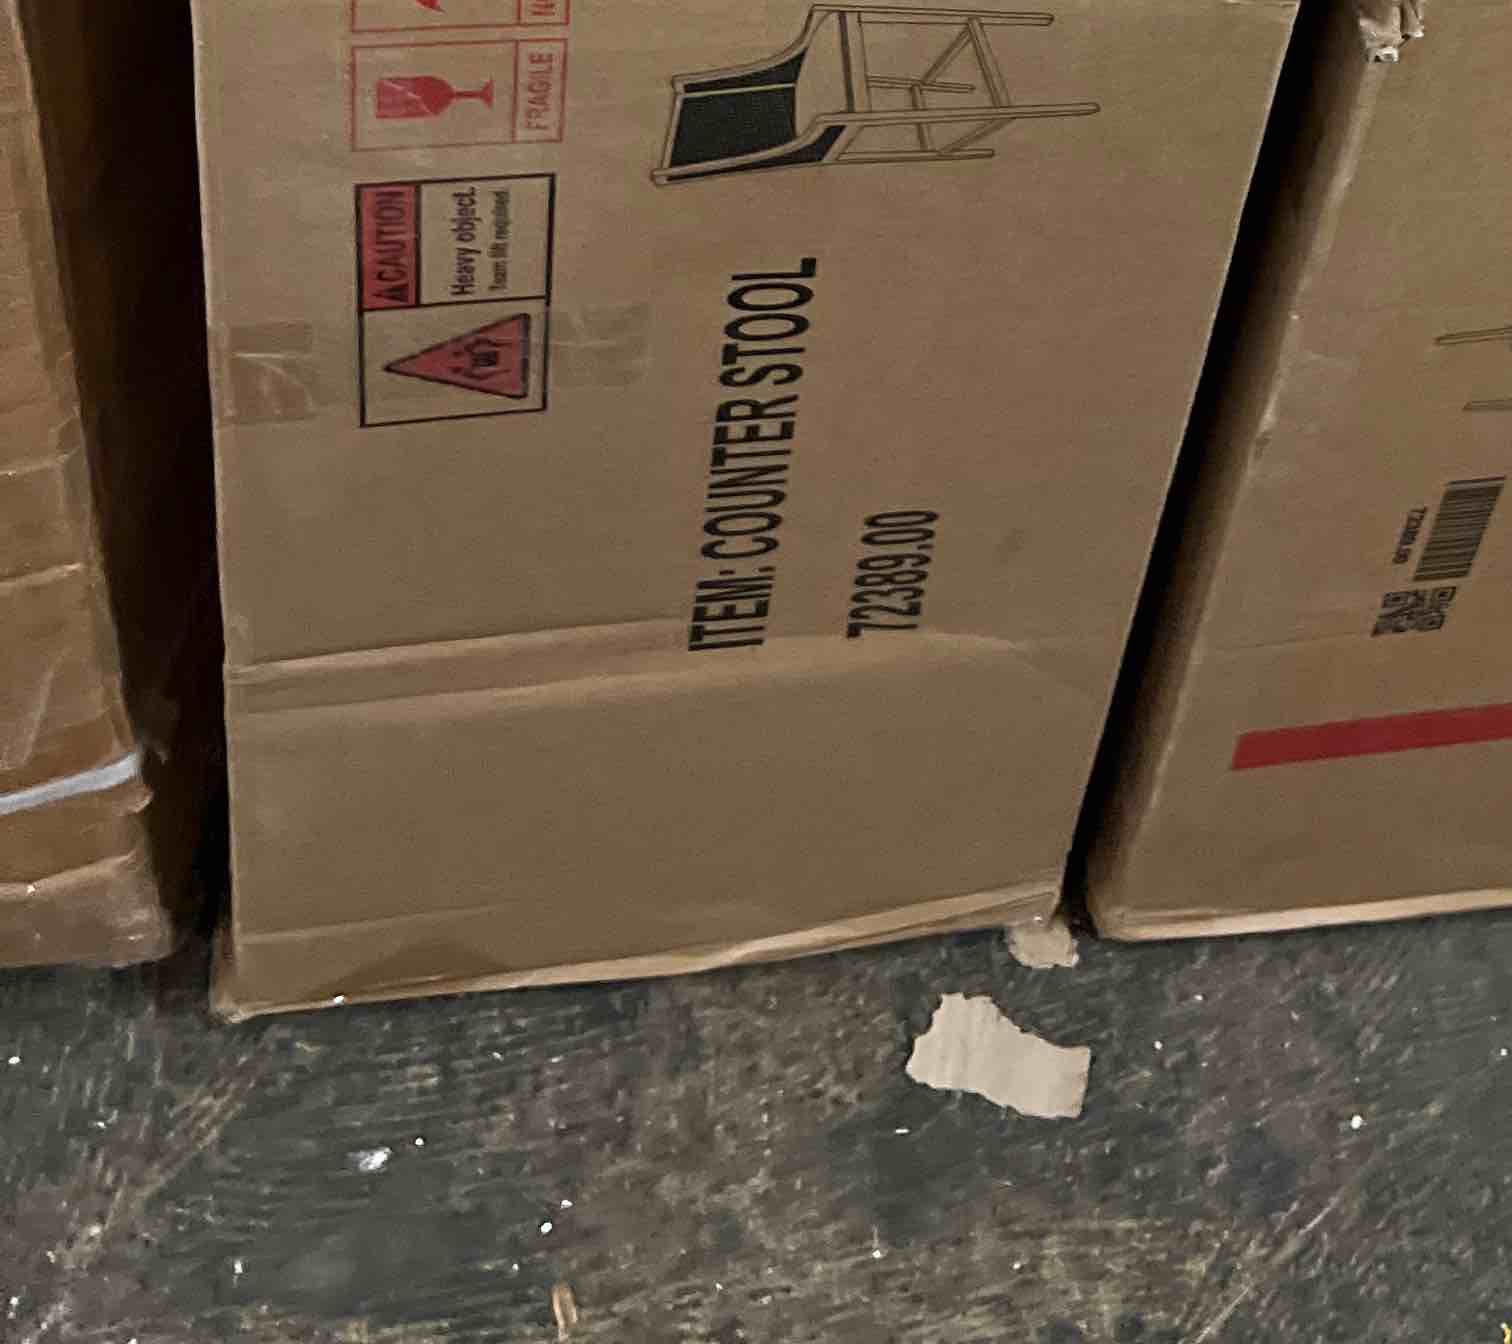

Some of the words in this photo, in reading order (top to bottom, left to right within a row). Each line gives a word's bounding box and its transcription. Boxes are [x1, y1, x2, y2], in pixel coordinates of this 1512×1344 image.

[524, 50, 556, 133] FRAGILE
[373, 190, 407, 282] CAUTION
[449, 186, 483, 243] object.
[450, 246, 482, 296] Heavy
[718, 256, 818, 388] STOOL
[700, 393, 800, 560] COUNTER
[687, 564, 778, 653] ITEM:
[846, 509, 940, 641] 72389.00
